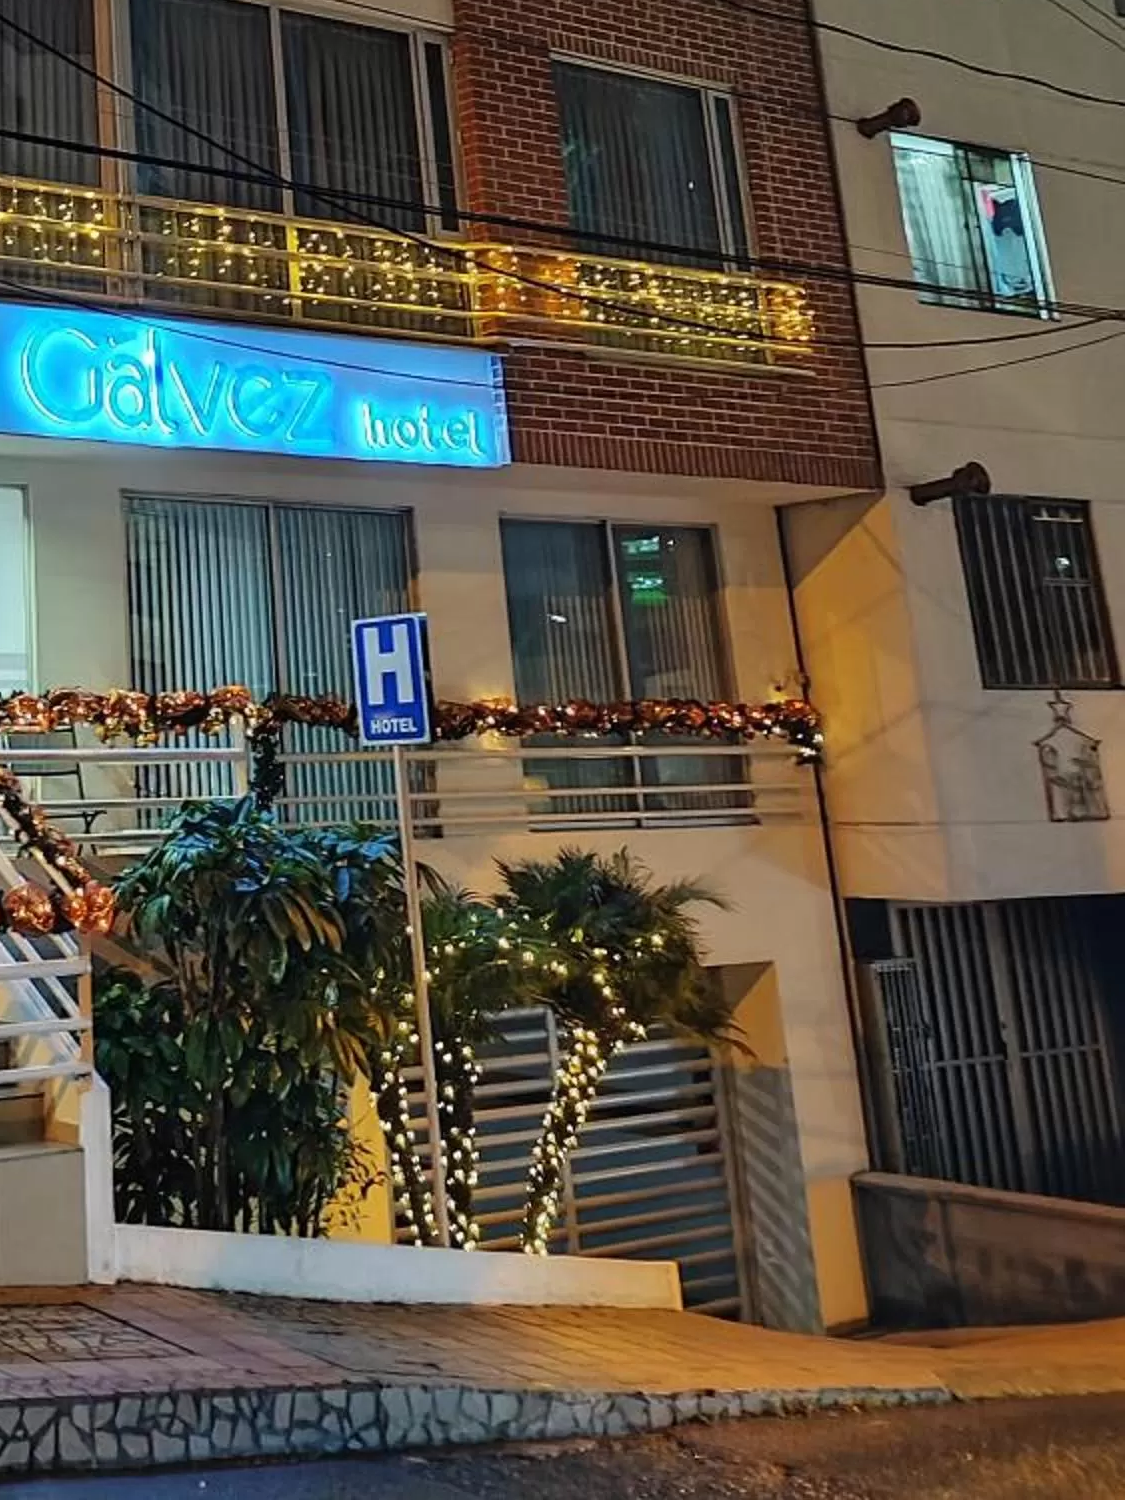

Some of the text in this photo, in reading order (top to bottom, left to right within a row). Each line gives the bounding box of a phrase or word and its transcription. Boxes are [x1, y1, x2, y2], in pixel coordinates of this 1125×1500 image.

[362, 398, 487, 458] hotel
[363, 624, 415, 706] H
[371, 717, 418, 734] HOTEL
